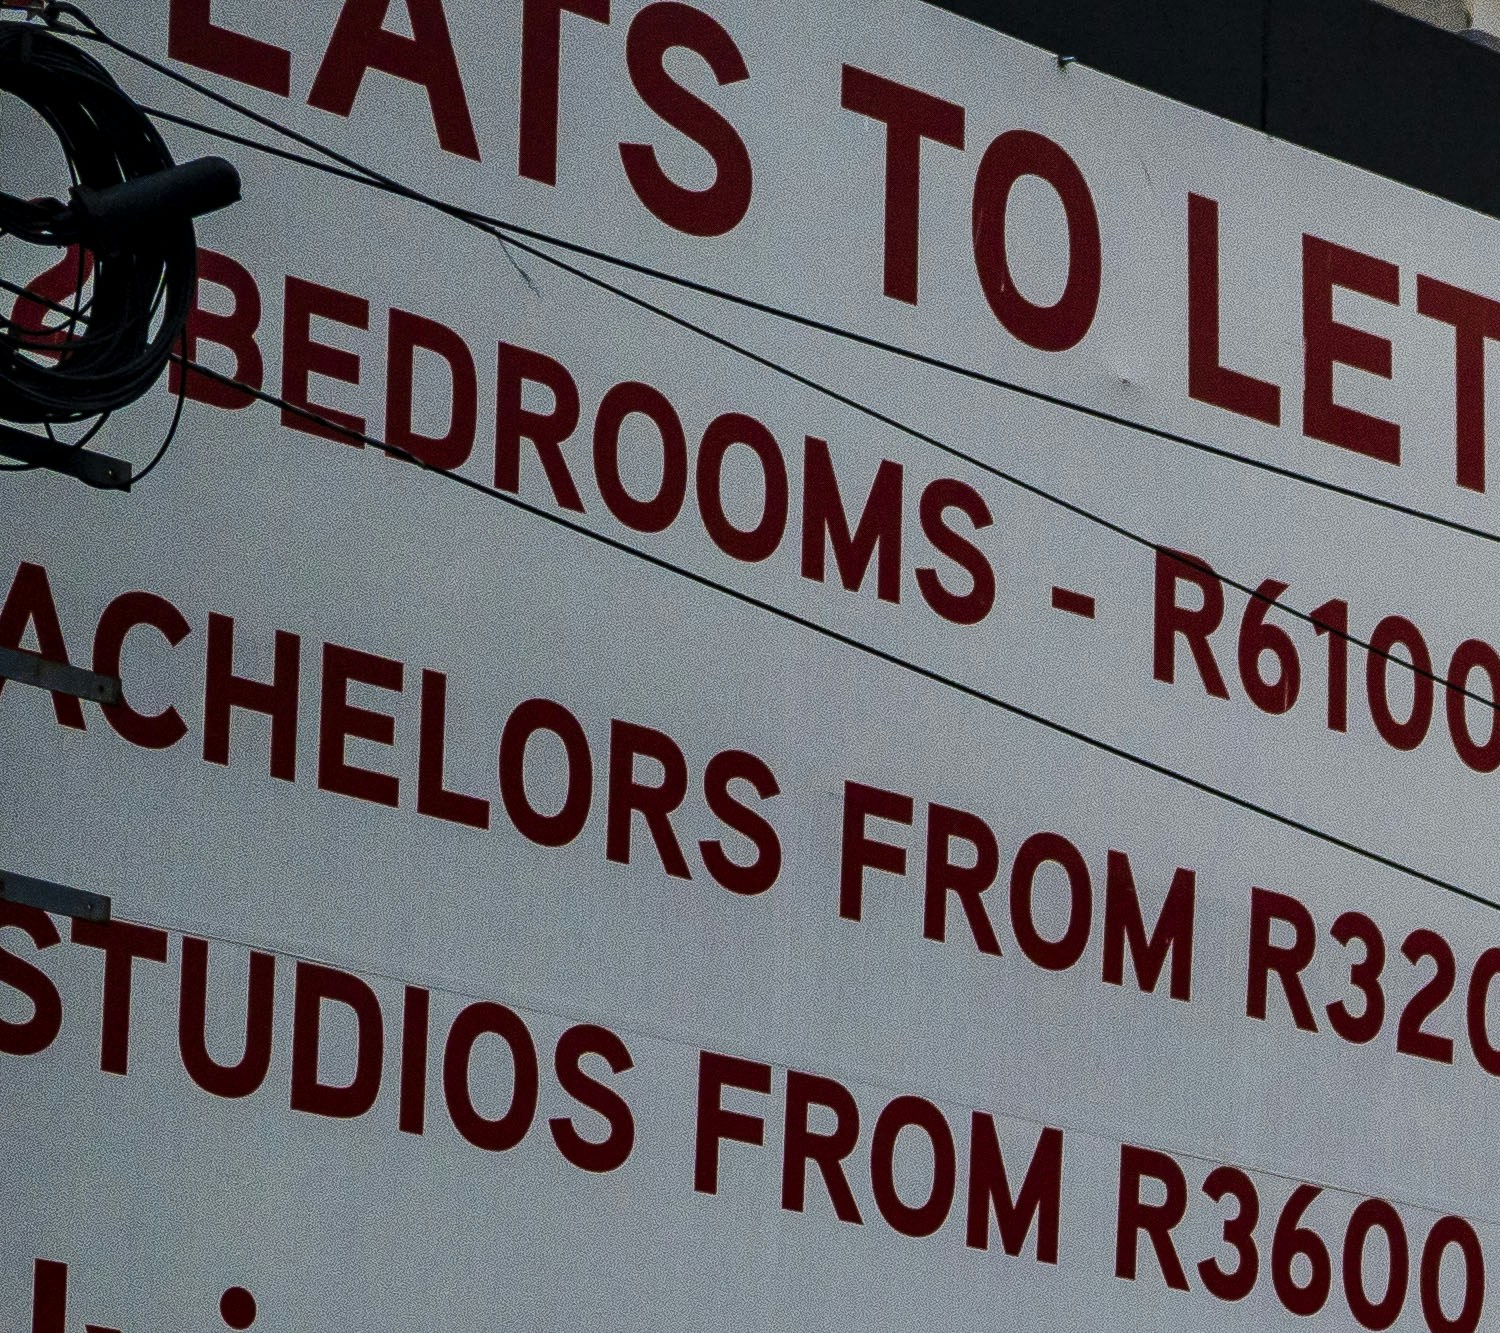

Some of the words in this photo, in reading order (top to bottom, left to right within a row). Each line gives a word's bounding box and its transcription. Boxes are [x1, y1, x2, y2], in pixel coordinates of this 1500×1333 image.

[839, 62, 1102, 352] TO
[168, 246, 994, 627] BEDROOMS
[838, 781, 1197, 1001] FROM
[0, 903, 636, 1173] STUDIOS
[695, 1051, 1063, 1266] FROM
